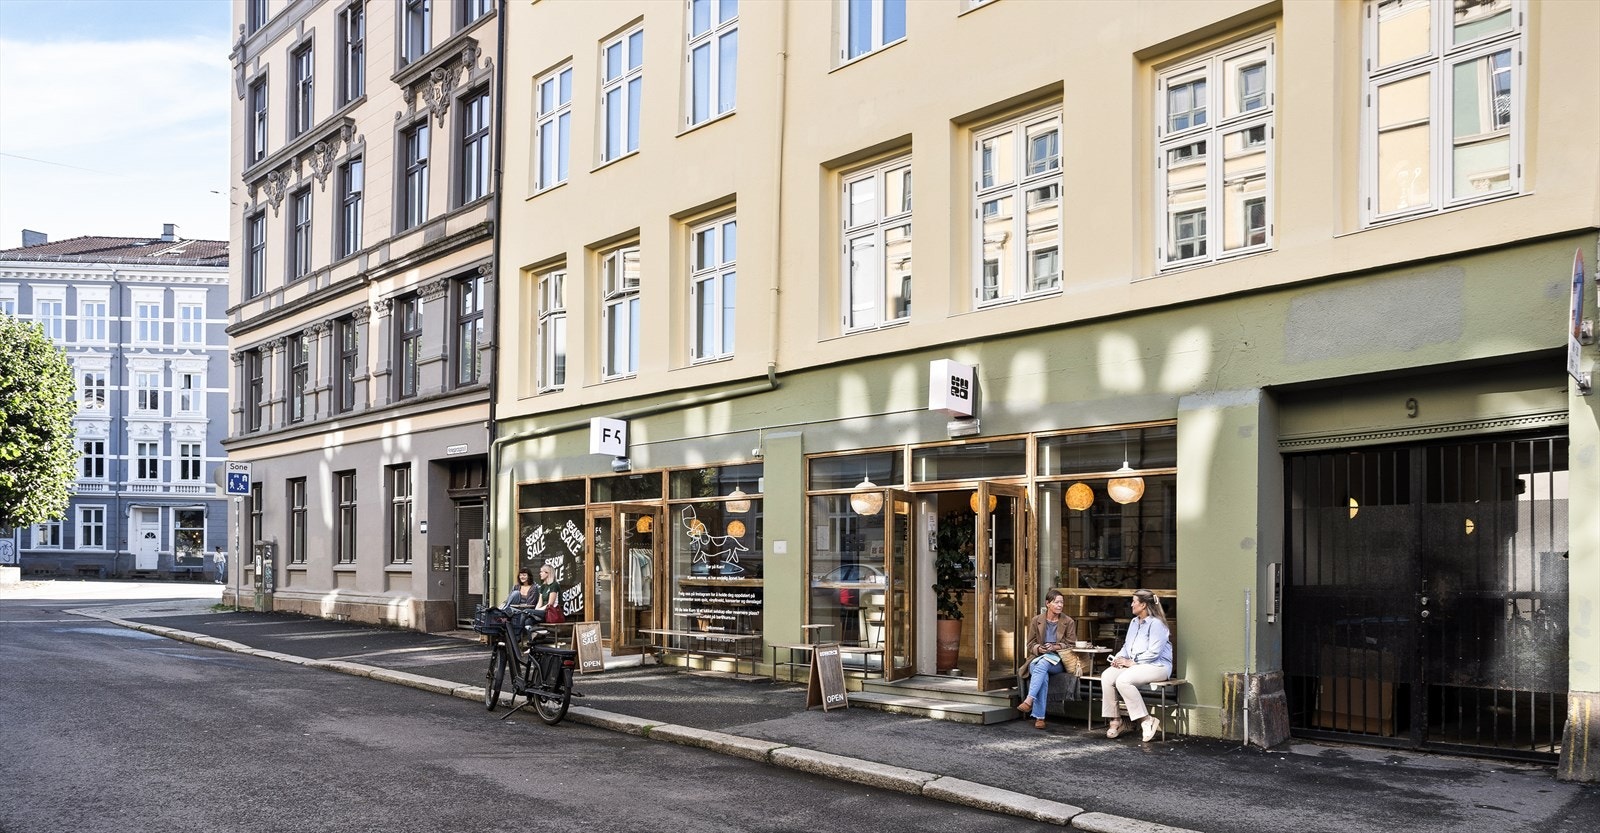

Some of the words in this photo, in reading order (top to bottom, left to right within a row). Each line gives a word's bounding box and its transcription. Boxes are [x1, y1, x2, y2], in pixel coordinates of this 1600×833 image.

[1406, 398, 1418, 418] 9
[526, 525, 543, 546] SEASON
[566, 520, 585, 543] SEASON
[527, 534, 546, 560] SALE
[560, 528, 581, 556] SALE
[555, 566, 564, 582] LE
[562, 582, 581, 602] SEASON
[563, 593, 583, 616] SALE
[582, 634, 597, 646] SALE
[827, 693, 844, 703] OPEN
